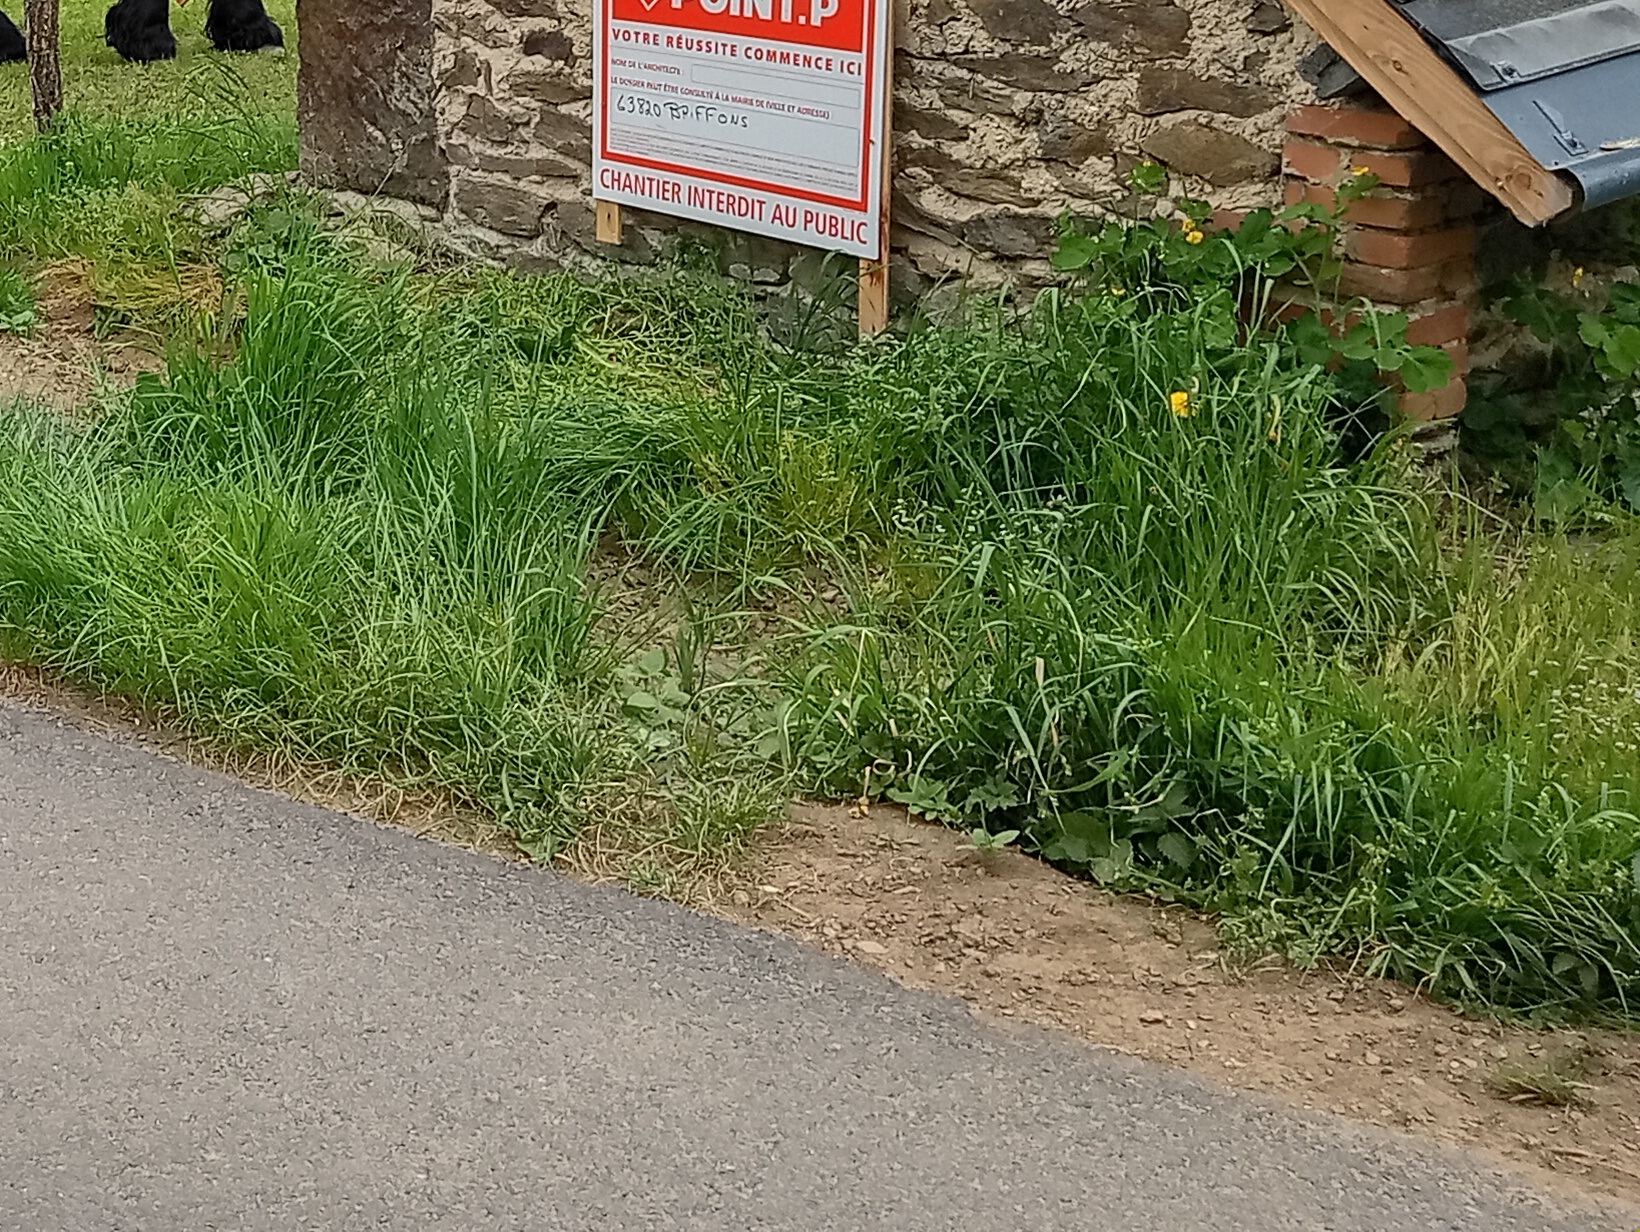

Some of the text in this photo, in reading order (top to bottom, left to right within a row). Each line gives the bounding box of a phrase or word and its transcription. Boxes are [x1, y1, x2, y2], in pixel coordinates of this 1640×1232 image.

[610, 58, 627, 67] NOM
[628, 60, 636, 68] DE
[612, 28, 862, 76] VOTRE RÉUSSITE COMMENCE ICI
[610, 76, 618, 84] LE
[619, 78, 645, 88] DOSSIER
[646, 82, 662, 91] PEUT
[721, 92, 730, 102] LA
[731, 96, 754, 106] MAIRIE
[755, 99, 765, 108] DE
[787, 104, 796, 113] ET
[616, 95, 661, 118] 63820
[600, 168, 868, 245] CHANTIER INTERDIT AU PUBLIC
